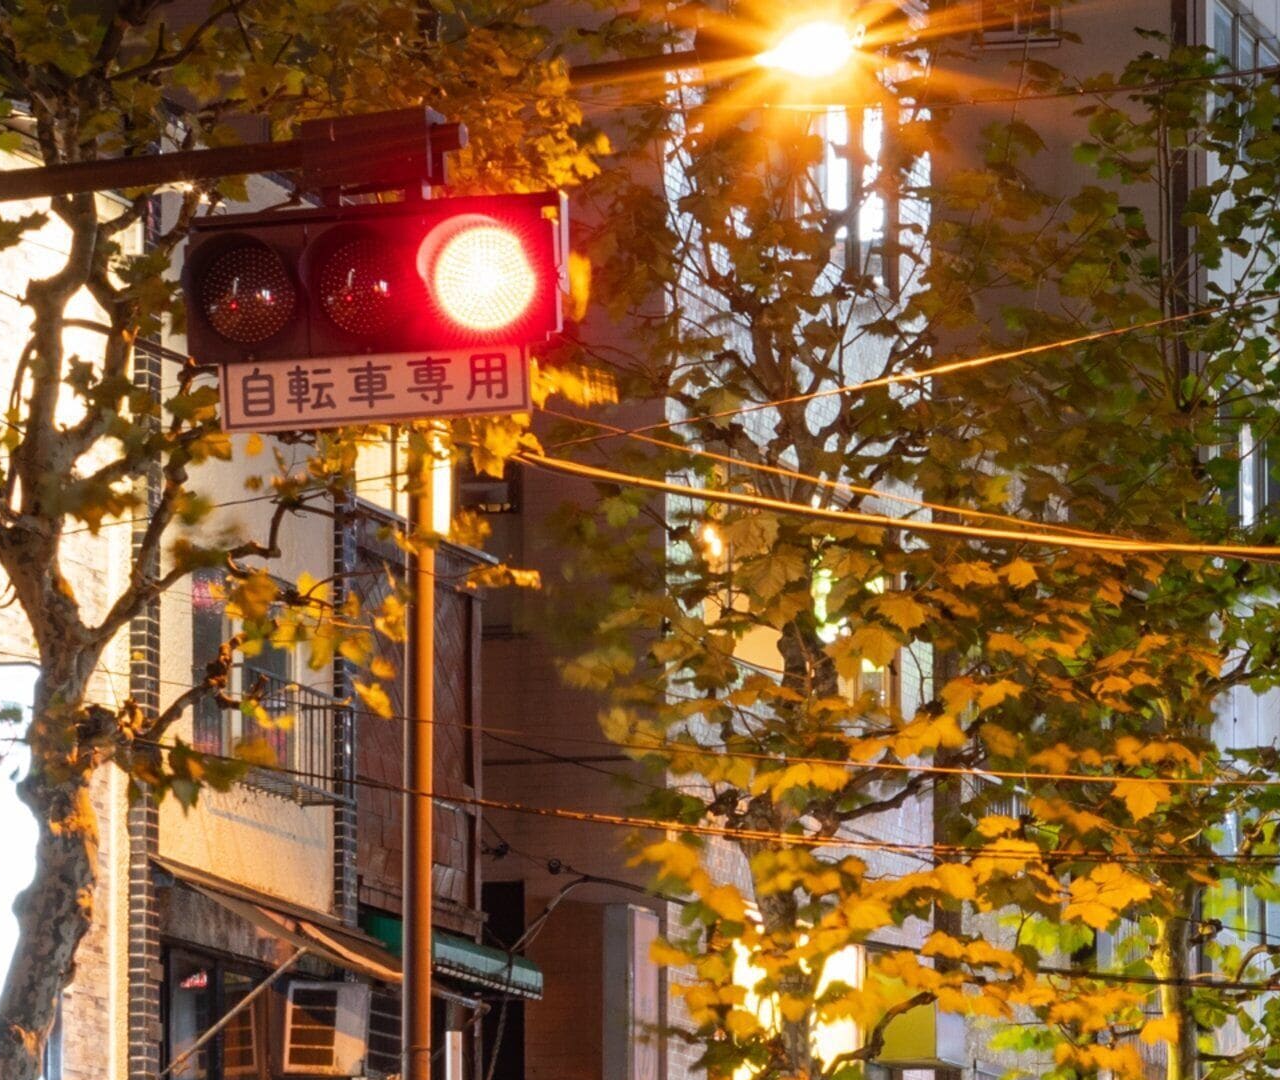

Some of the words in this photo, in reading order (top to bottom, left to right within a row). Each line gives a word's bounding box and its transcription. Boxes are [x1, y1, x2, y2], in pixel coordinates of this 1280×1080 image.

[240, 351, 509, 418] 自転車専用
